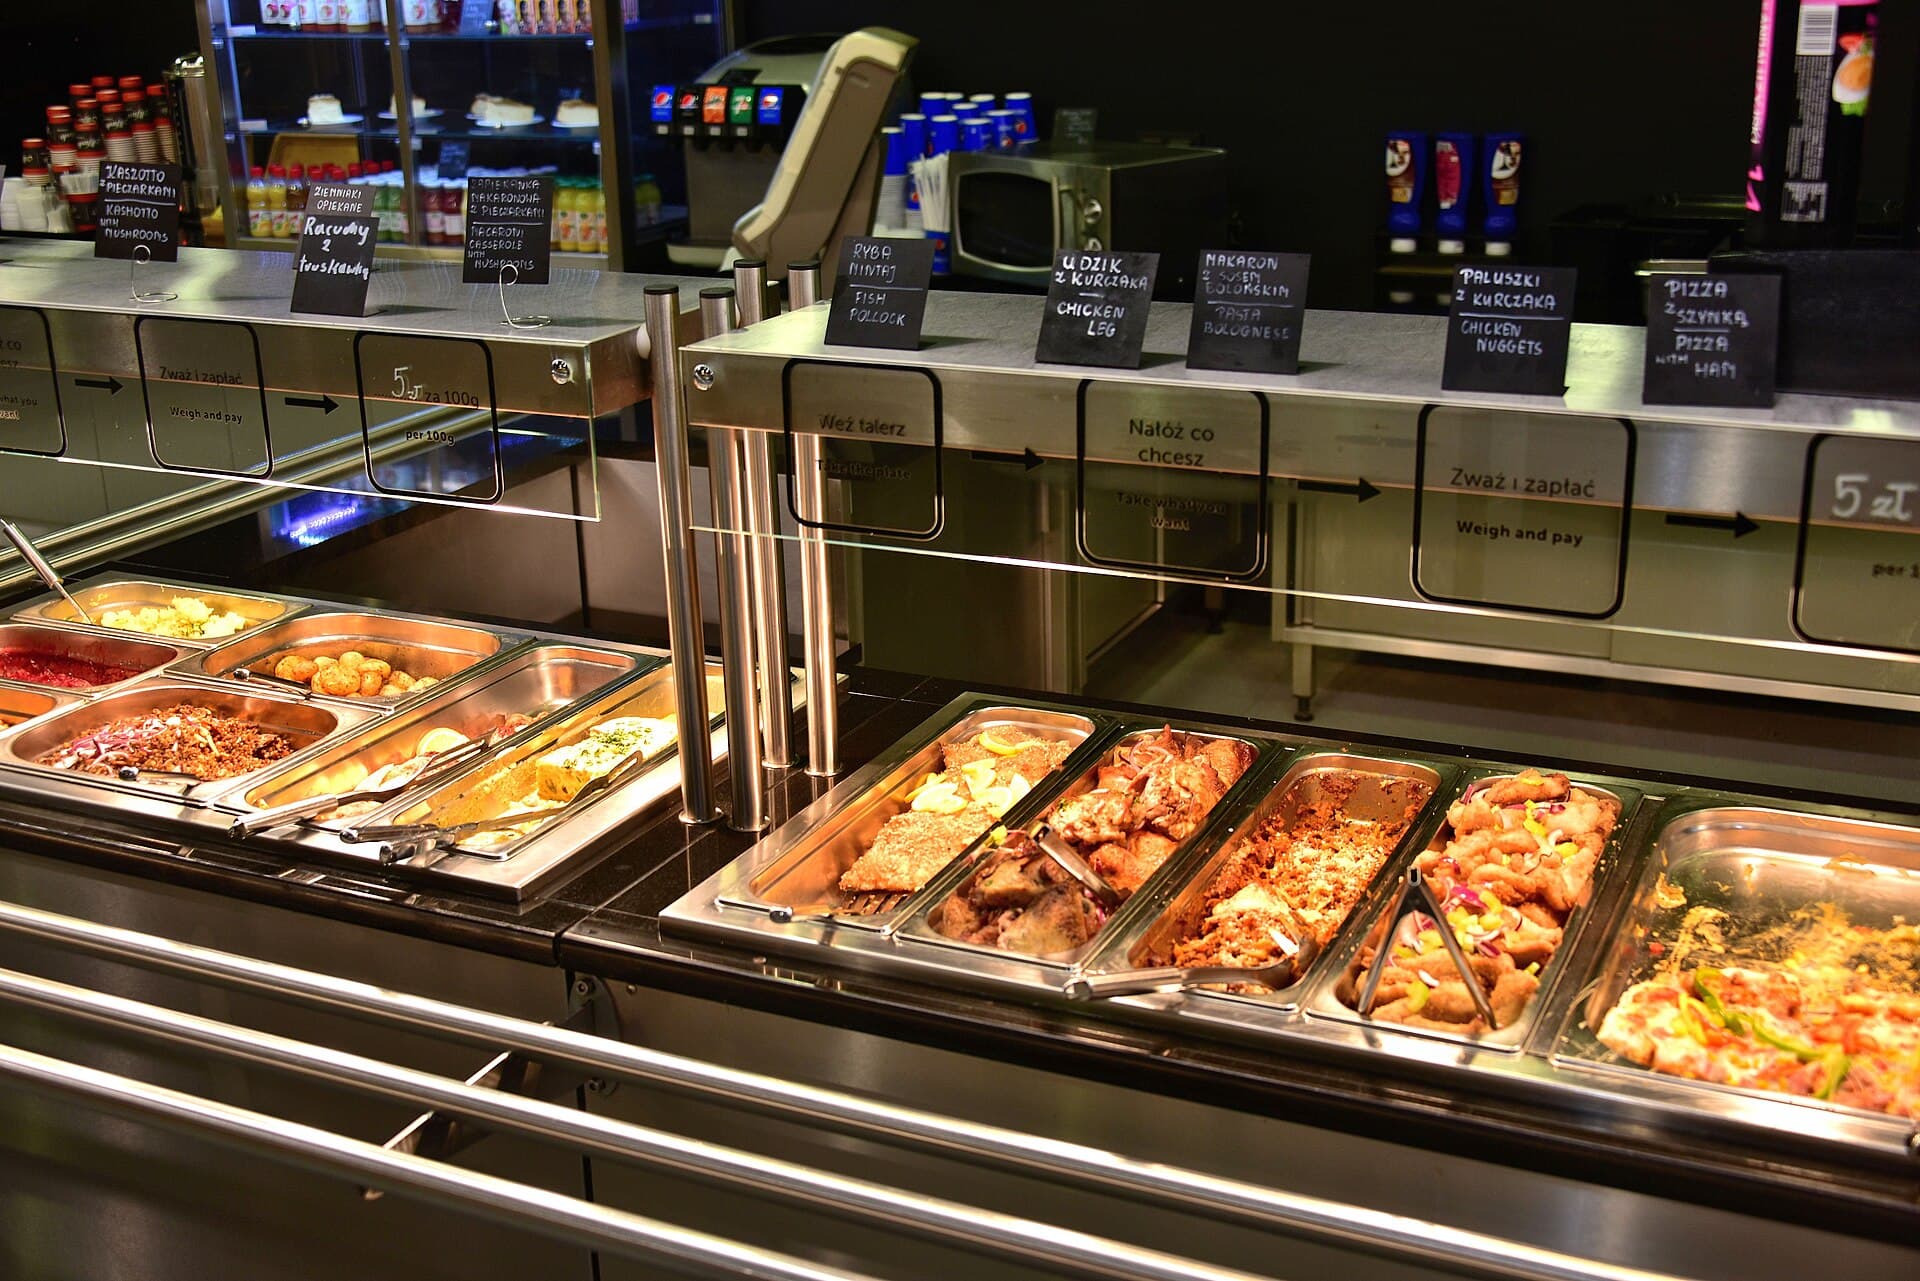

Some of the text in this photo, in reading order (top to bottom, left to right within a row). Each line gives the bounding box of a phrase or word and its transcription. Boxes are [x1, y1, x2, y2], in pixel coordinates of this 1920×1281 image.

[314, 186, 361, 199] ZIEMNIAKI
[317, 200, 362, 212] OPIEKANE
[469, 239, 524, 250] CASSEROLE
[853, 243, 892, 260] RYBA
[1071, 271, 1148, 291] KURCZAKA
[1664, 279, 1729, 299] PIZZA
[855, 291, 887, 306] FISH
[1472, 292, 1556, 311] KURCZAKA
[849, 307, 906, 327] POLLOCK
[1057, 301, 1125, 319] CHICKEN
[1216, 305, 1261, 321] PASTA
[1087, 320, 1116, 337] LEG
[1461, 320, 1522, 337] CHICKEN
[1476, 338, 1543, 356] NUGGETS
[1675, 334, 1729, 352] PIZZA
[424, 391, 440, 403] za
[169, 406, 243, 425] Weigh and pay
[859, 417, 906, 438] talerz
[1190, 427, 1215, 443] co
[405, 430, 456, 446] per 100g
[1137, 447, 1205, 468] chcesz
[1450, 467, 1506, 491] Zważ
[1524, 477, 1596, 499] zapłać
[1455, 519, 1584, 548] Weigh and pay
